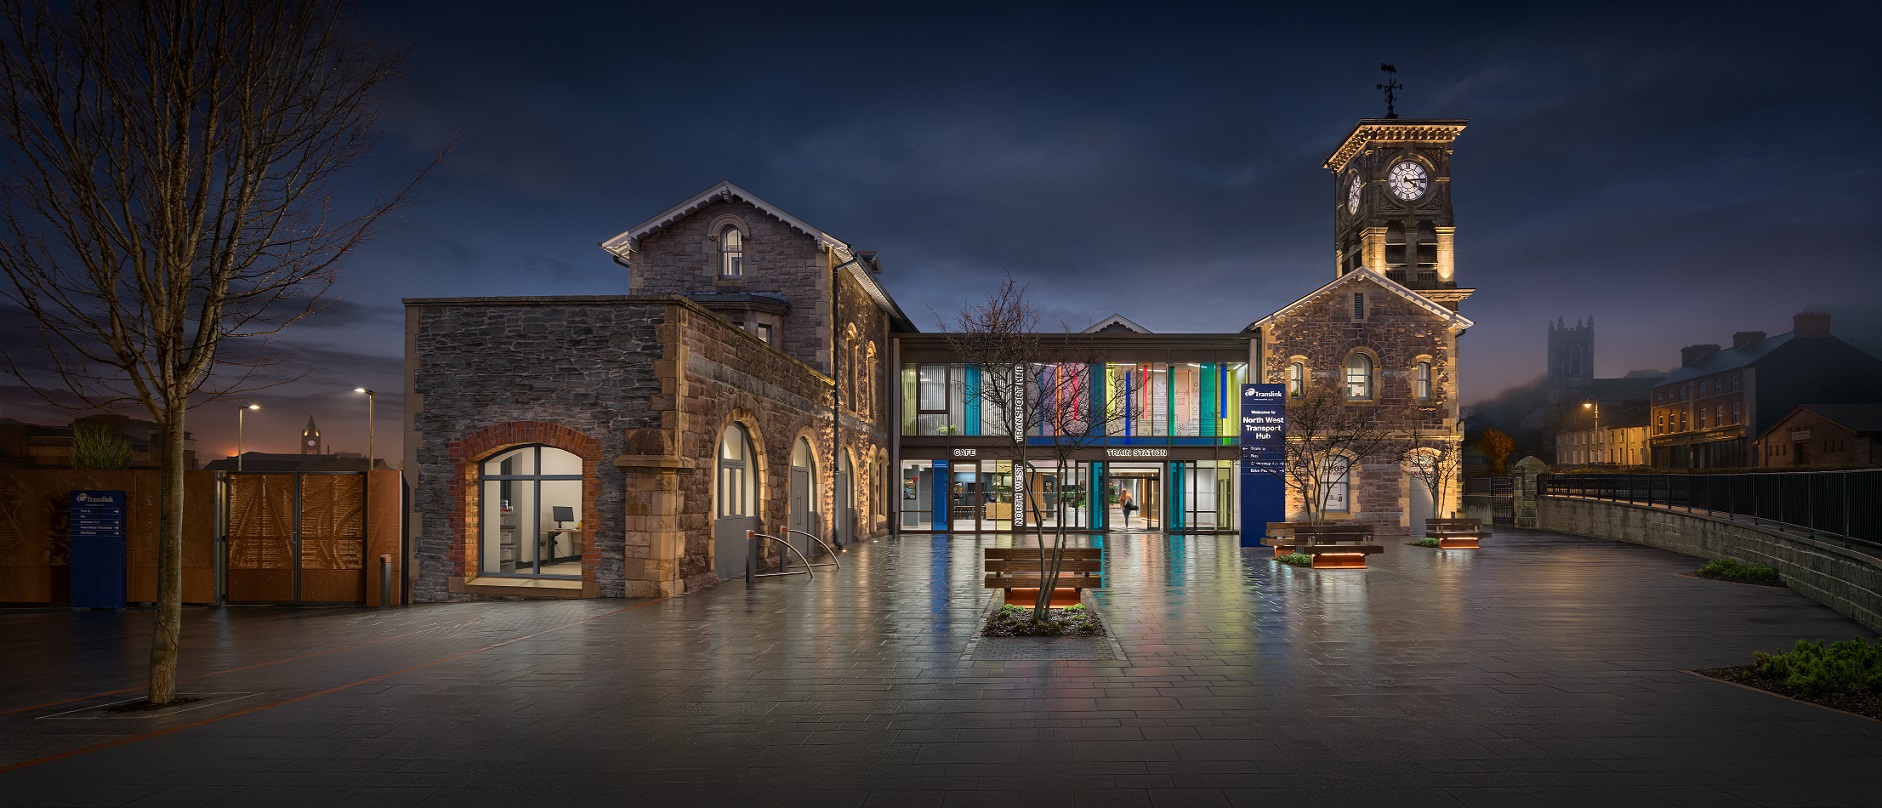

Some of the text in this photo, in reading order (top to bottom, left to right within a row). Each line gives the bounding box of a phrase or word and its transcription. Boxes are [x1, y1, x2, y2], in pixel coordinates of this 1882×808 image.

[1014, 364, 1024, 527] NORTH WEST TRANSPORT HUB
[954, 448, 976, 457] CAFE
[1106, 449, 1167, 457] TRAIN STATION
